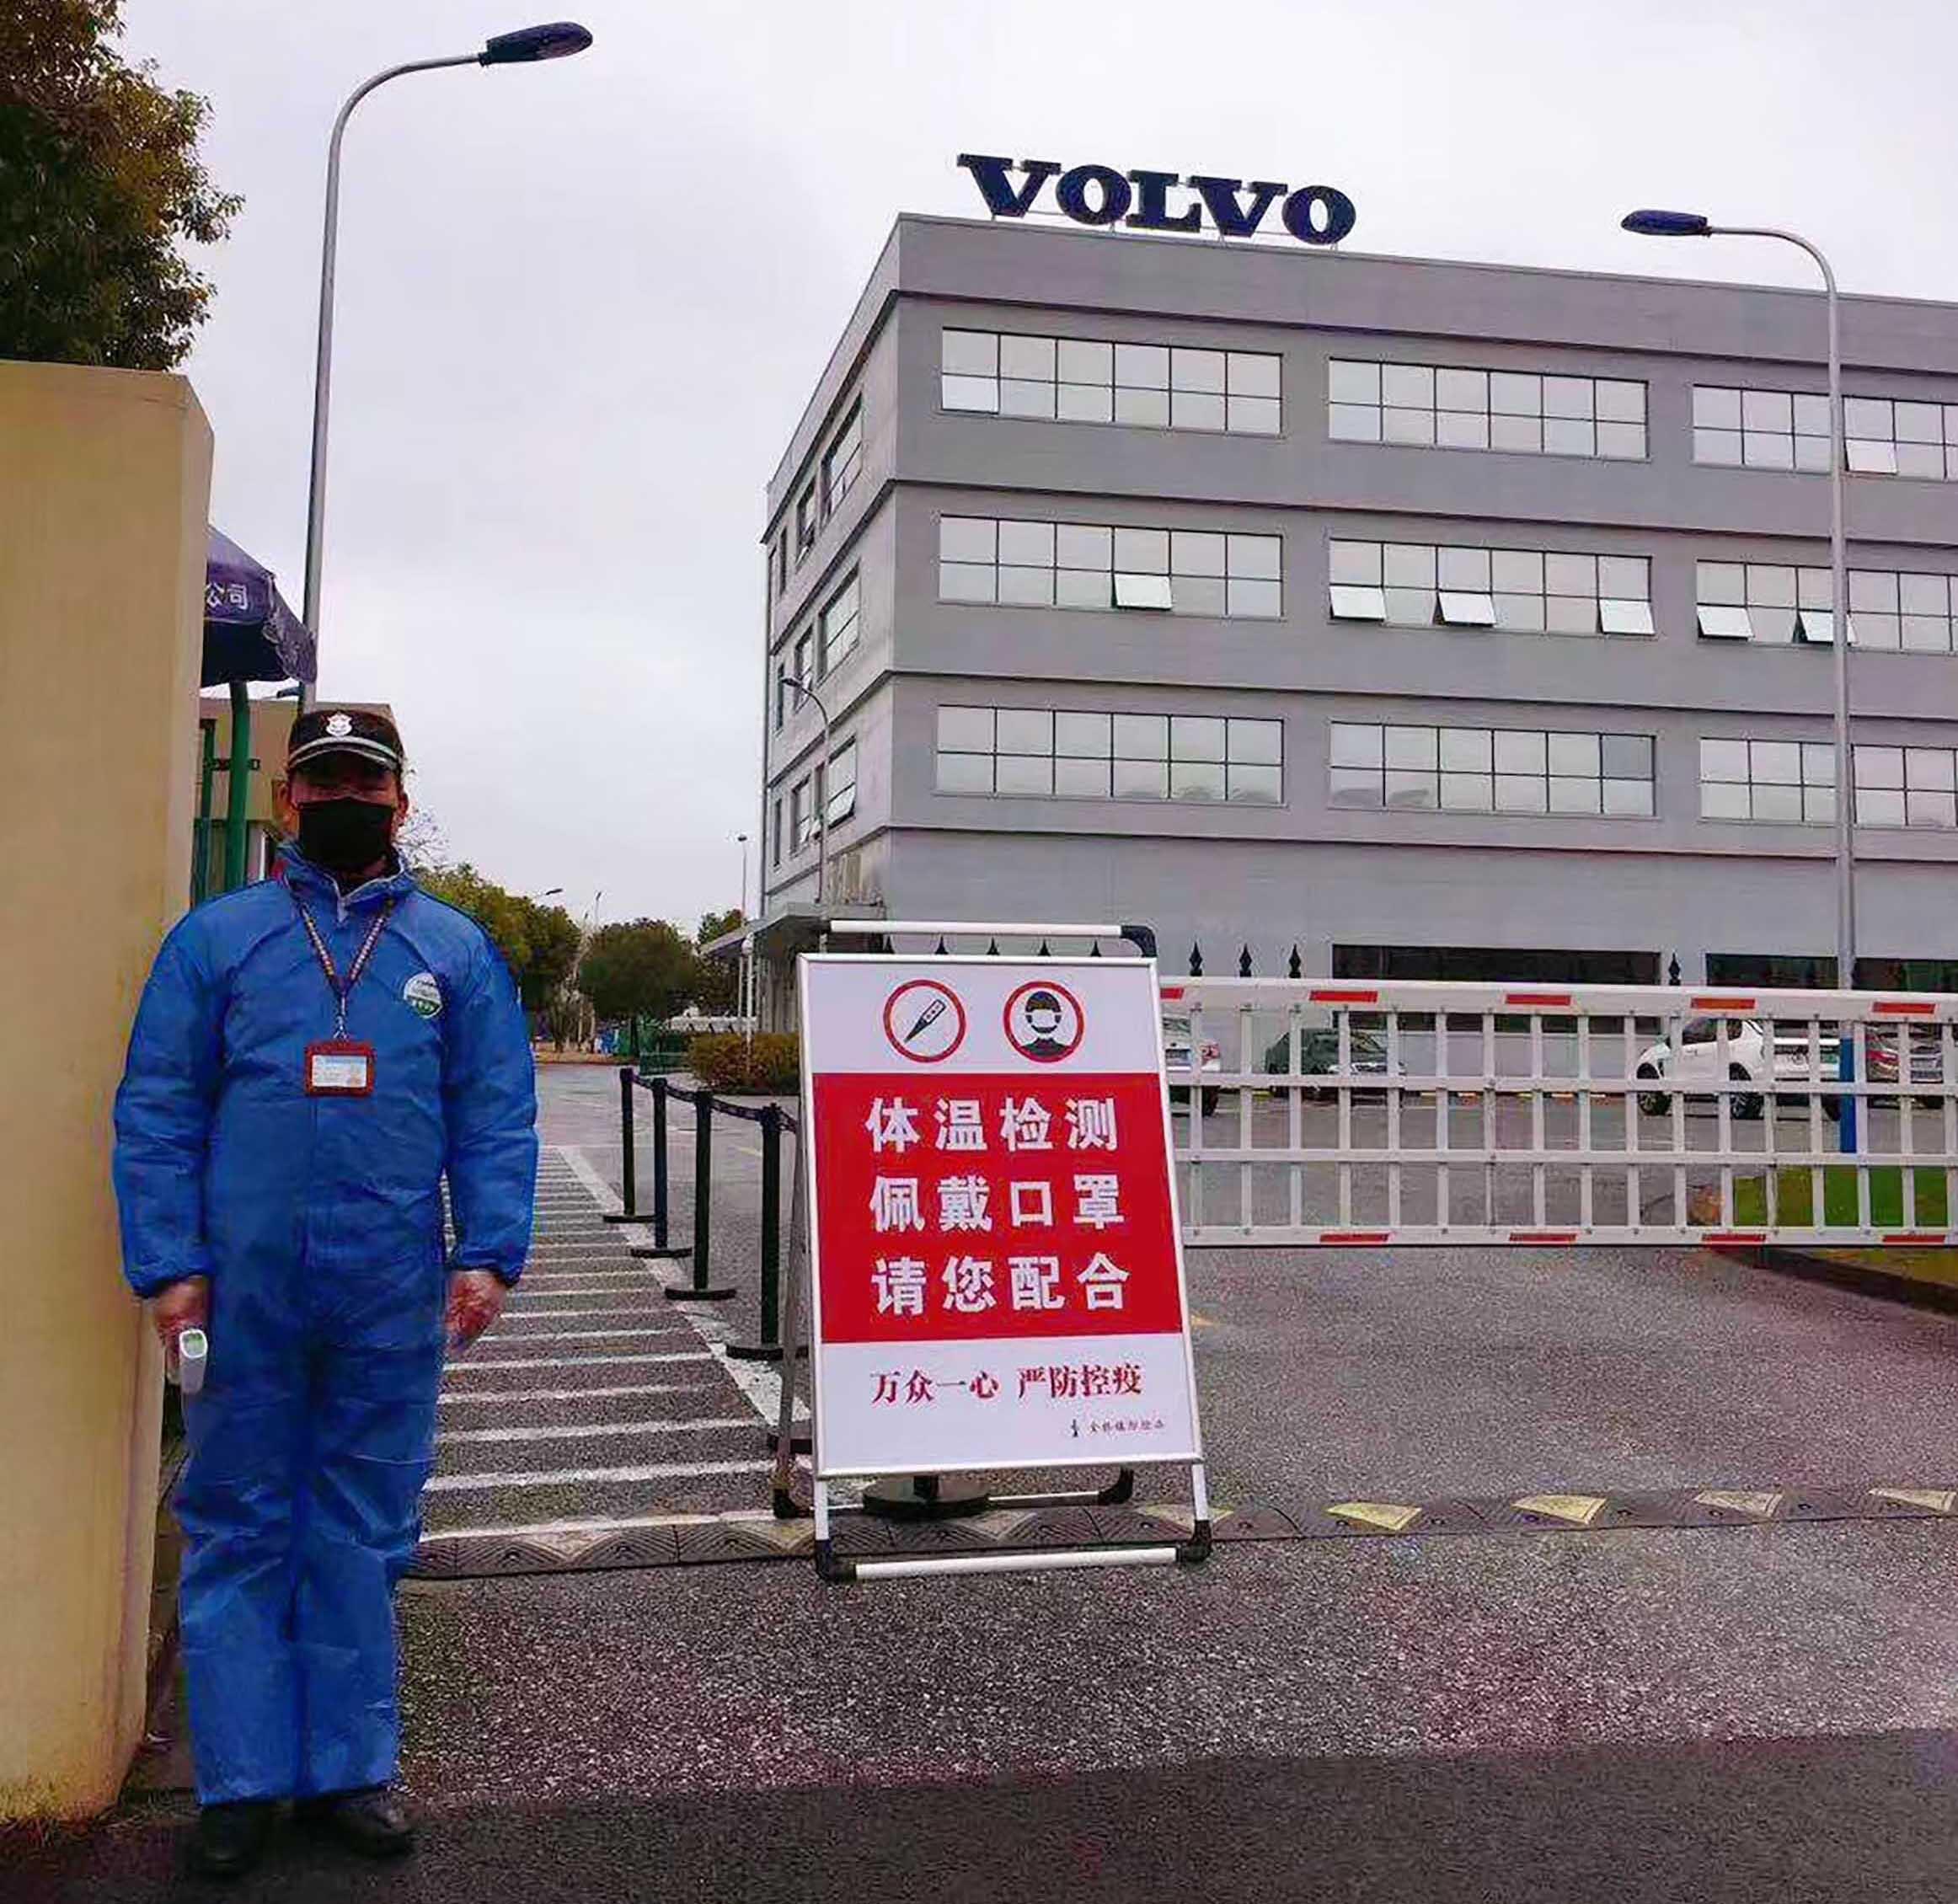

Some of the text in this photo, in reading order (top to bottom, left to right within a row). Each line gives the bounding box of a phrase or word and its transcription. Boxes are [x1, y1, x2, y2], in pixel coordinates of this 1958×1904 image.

[956, 152, 1356, 245] VOLVO
[205, 582, 249, 610] 公司
[865, 1096, 1118, 1153] 体温检测
[869, 1174, 1126, 1233] 佩戴口罩
[871, 1252, 1131, 1316] 请您配合
[870, 1363, 1142, 1404] 万众一心 严防控疫
